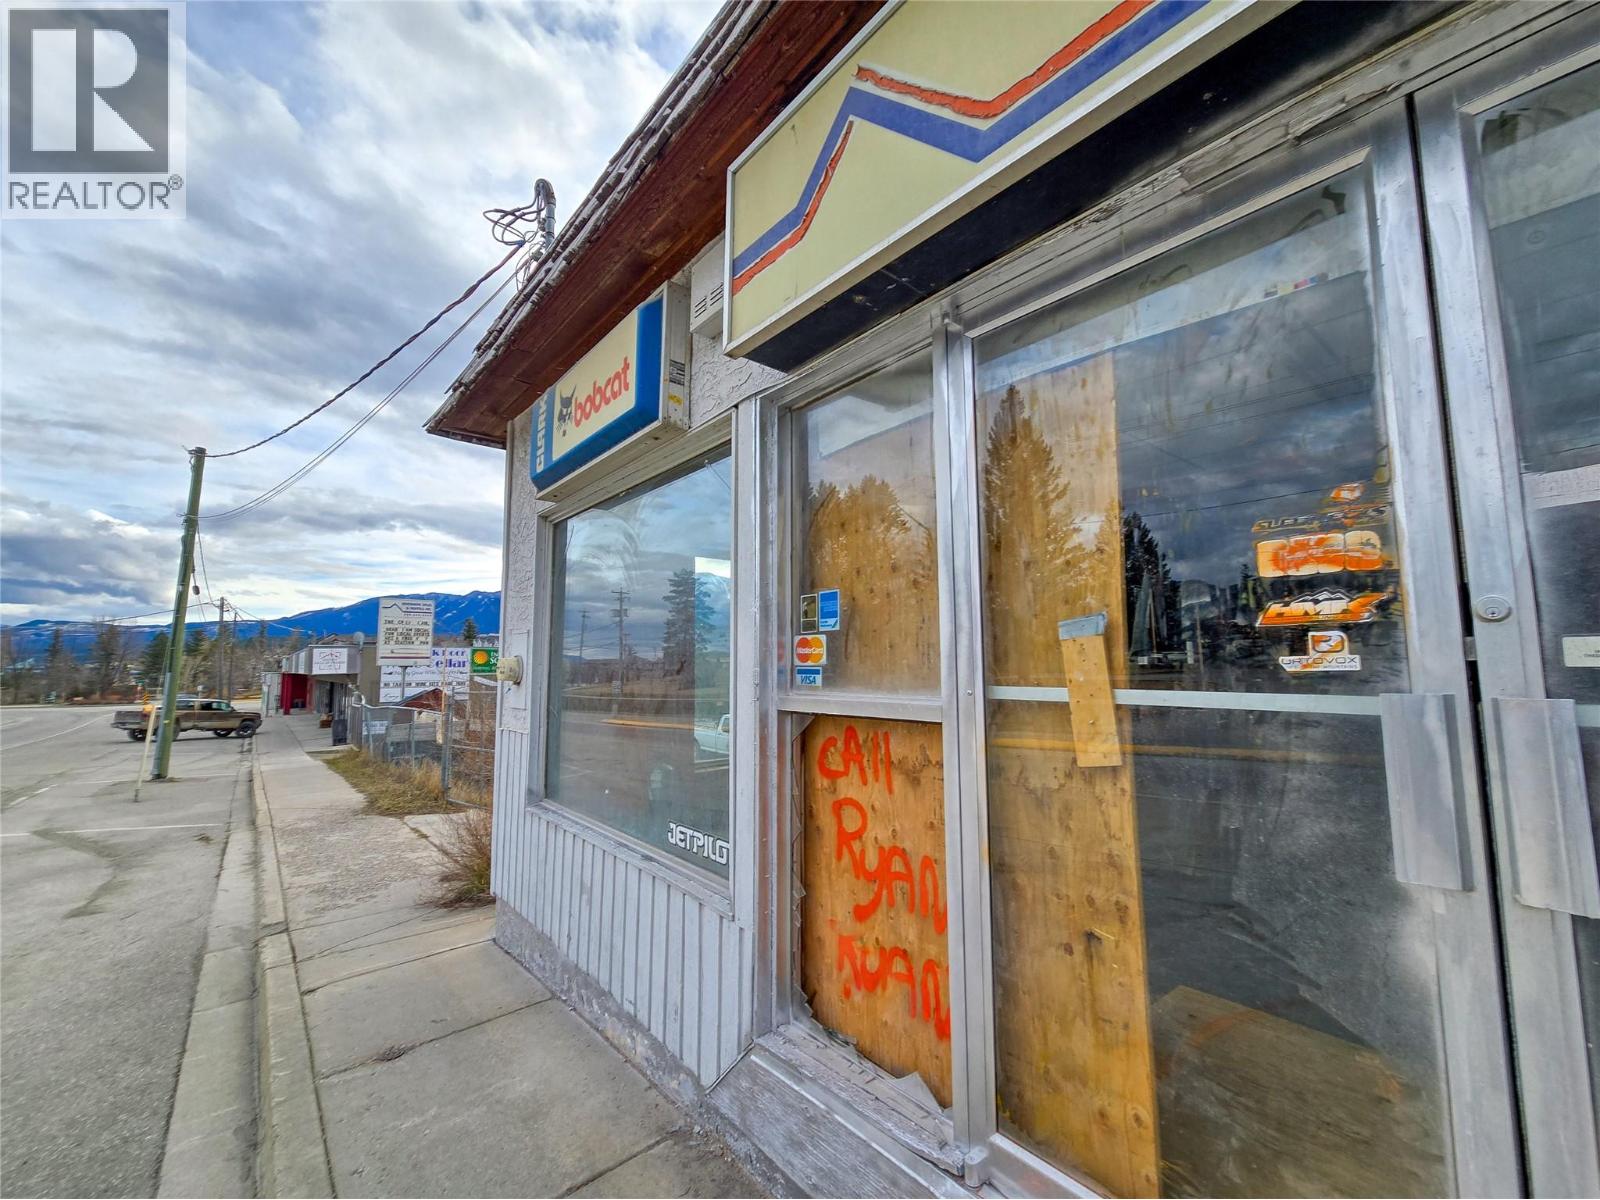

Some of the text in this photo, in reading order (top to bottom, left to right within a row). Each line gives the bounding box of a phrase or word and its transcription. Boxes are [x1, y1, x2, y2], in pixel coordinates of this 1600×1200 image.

[573, 356, 630, 429] bobcat
[800, 675, 817, 685] VISA
[667, 821, 730, 865] JETPILO
